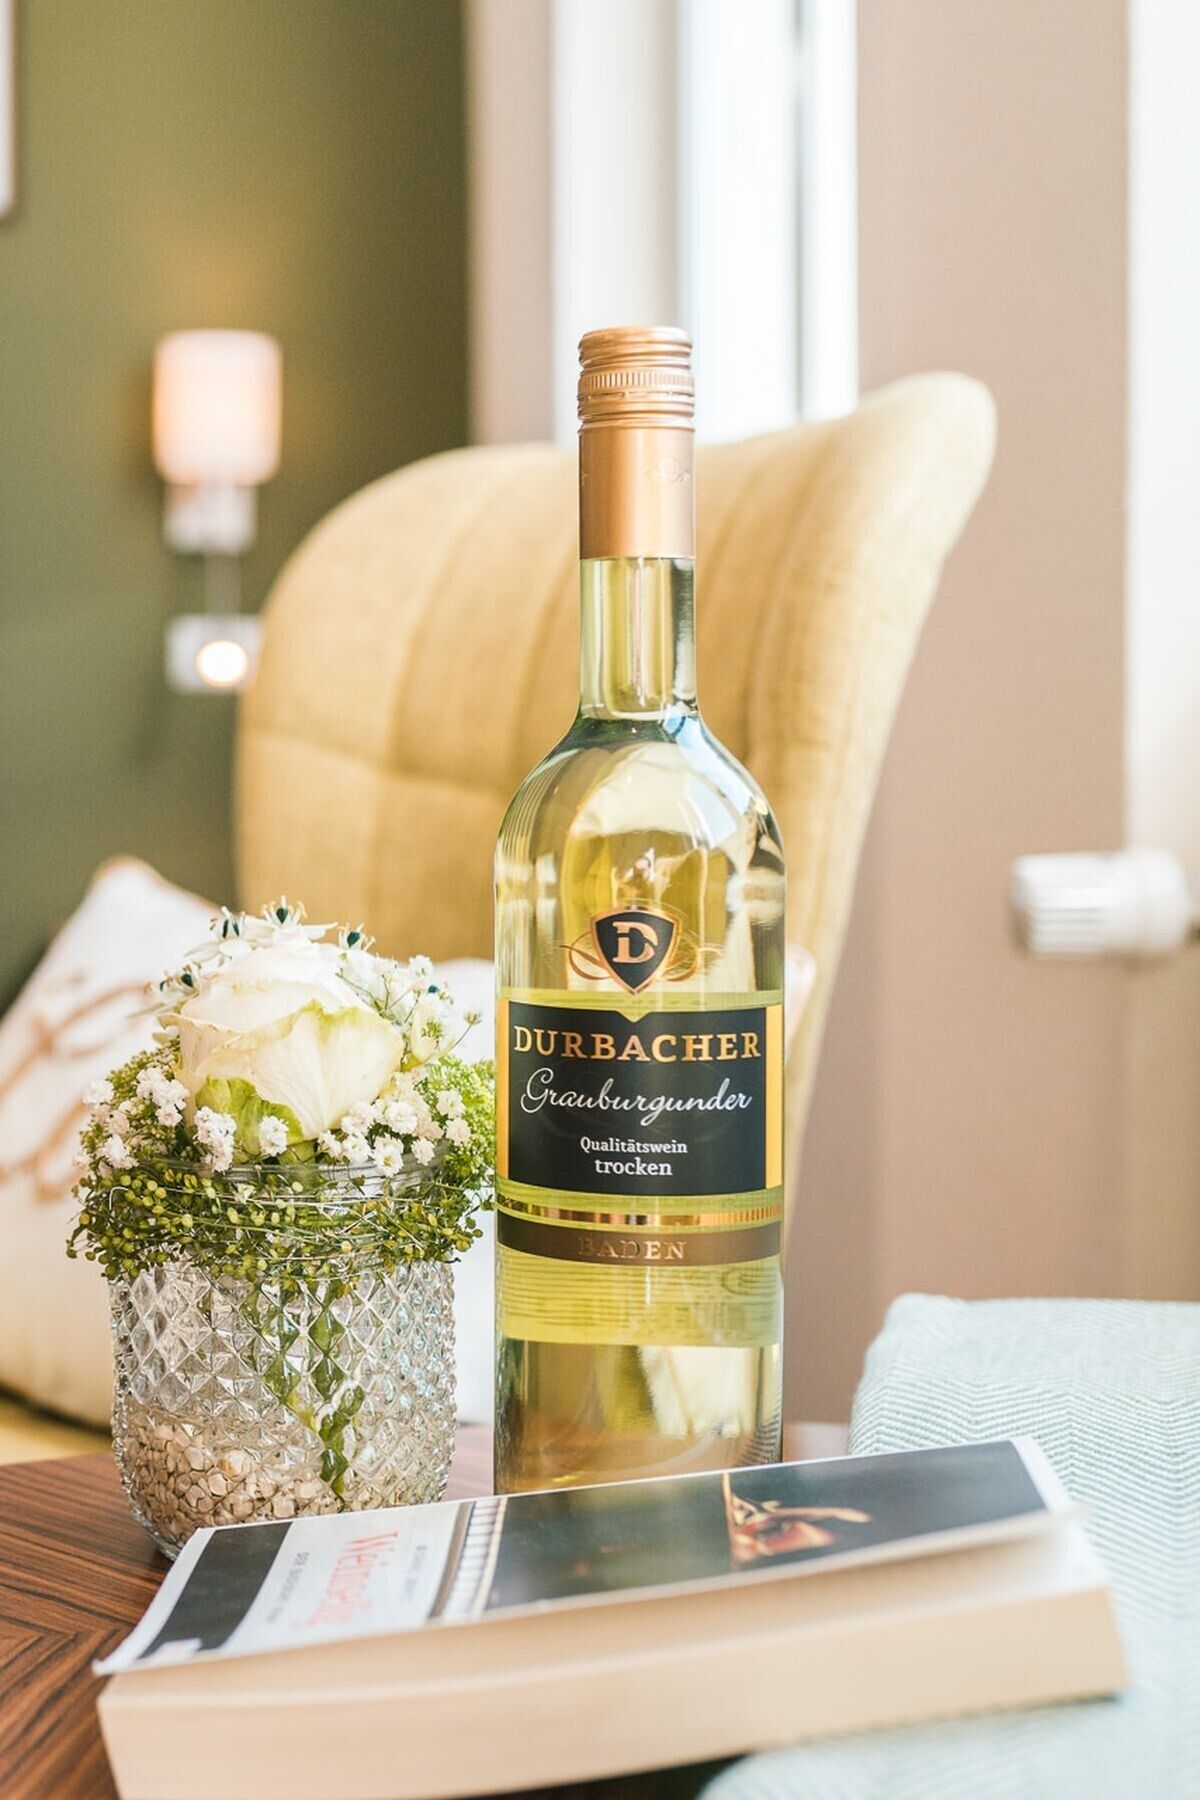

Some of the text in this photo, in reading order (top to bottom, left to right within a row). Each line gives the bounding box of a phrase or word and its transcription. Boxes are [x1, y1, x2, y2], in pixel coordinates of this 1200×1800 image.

[611, 920, 659, 965] D
[513, 1025, 762, 1063] DURBACHER
[520, 1066, 753, 1127] Grauburgunder
[579, 1136, 689, 1154] Qualitätswein
[594, 1157, 674, 1177] trocken
[576, 1236, 688, 1261] BADEN
